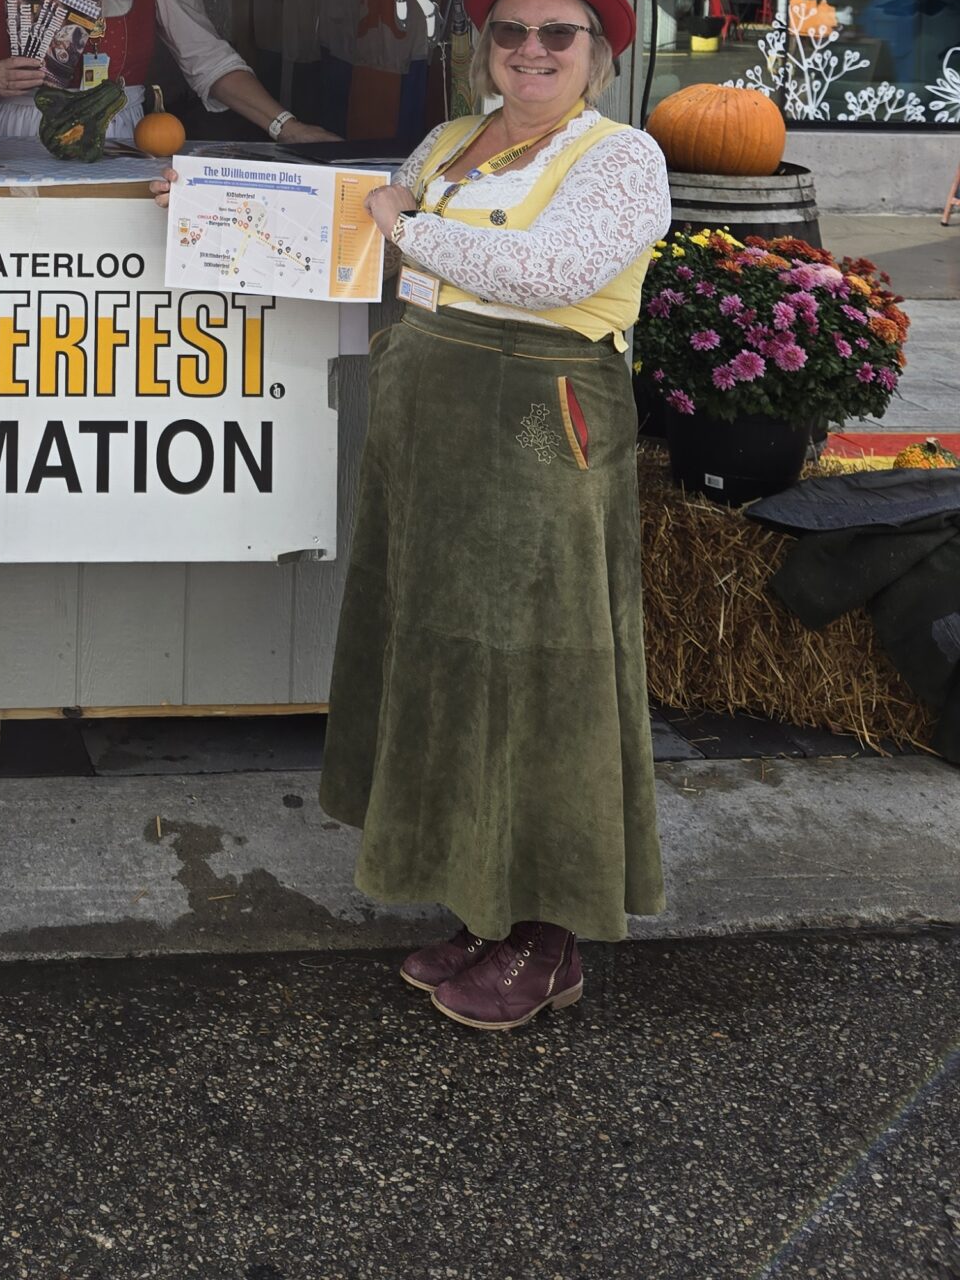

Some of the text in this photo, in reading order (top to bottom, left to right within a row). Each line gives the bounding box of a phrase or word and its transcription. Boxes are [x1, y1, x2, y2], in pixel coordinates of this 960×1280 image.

[203, 166, 219, 177] The
[221, 167, 277, 182] Willkommen
[279, 171, 302, 185] Platz
